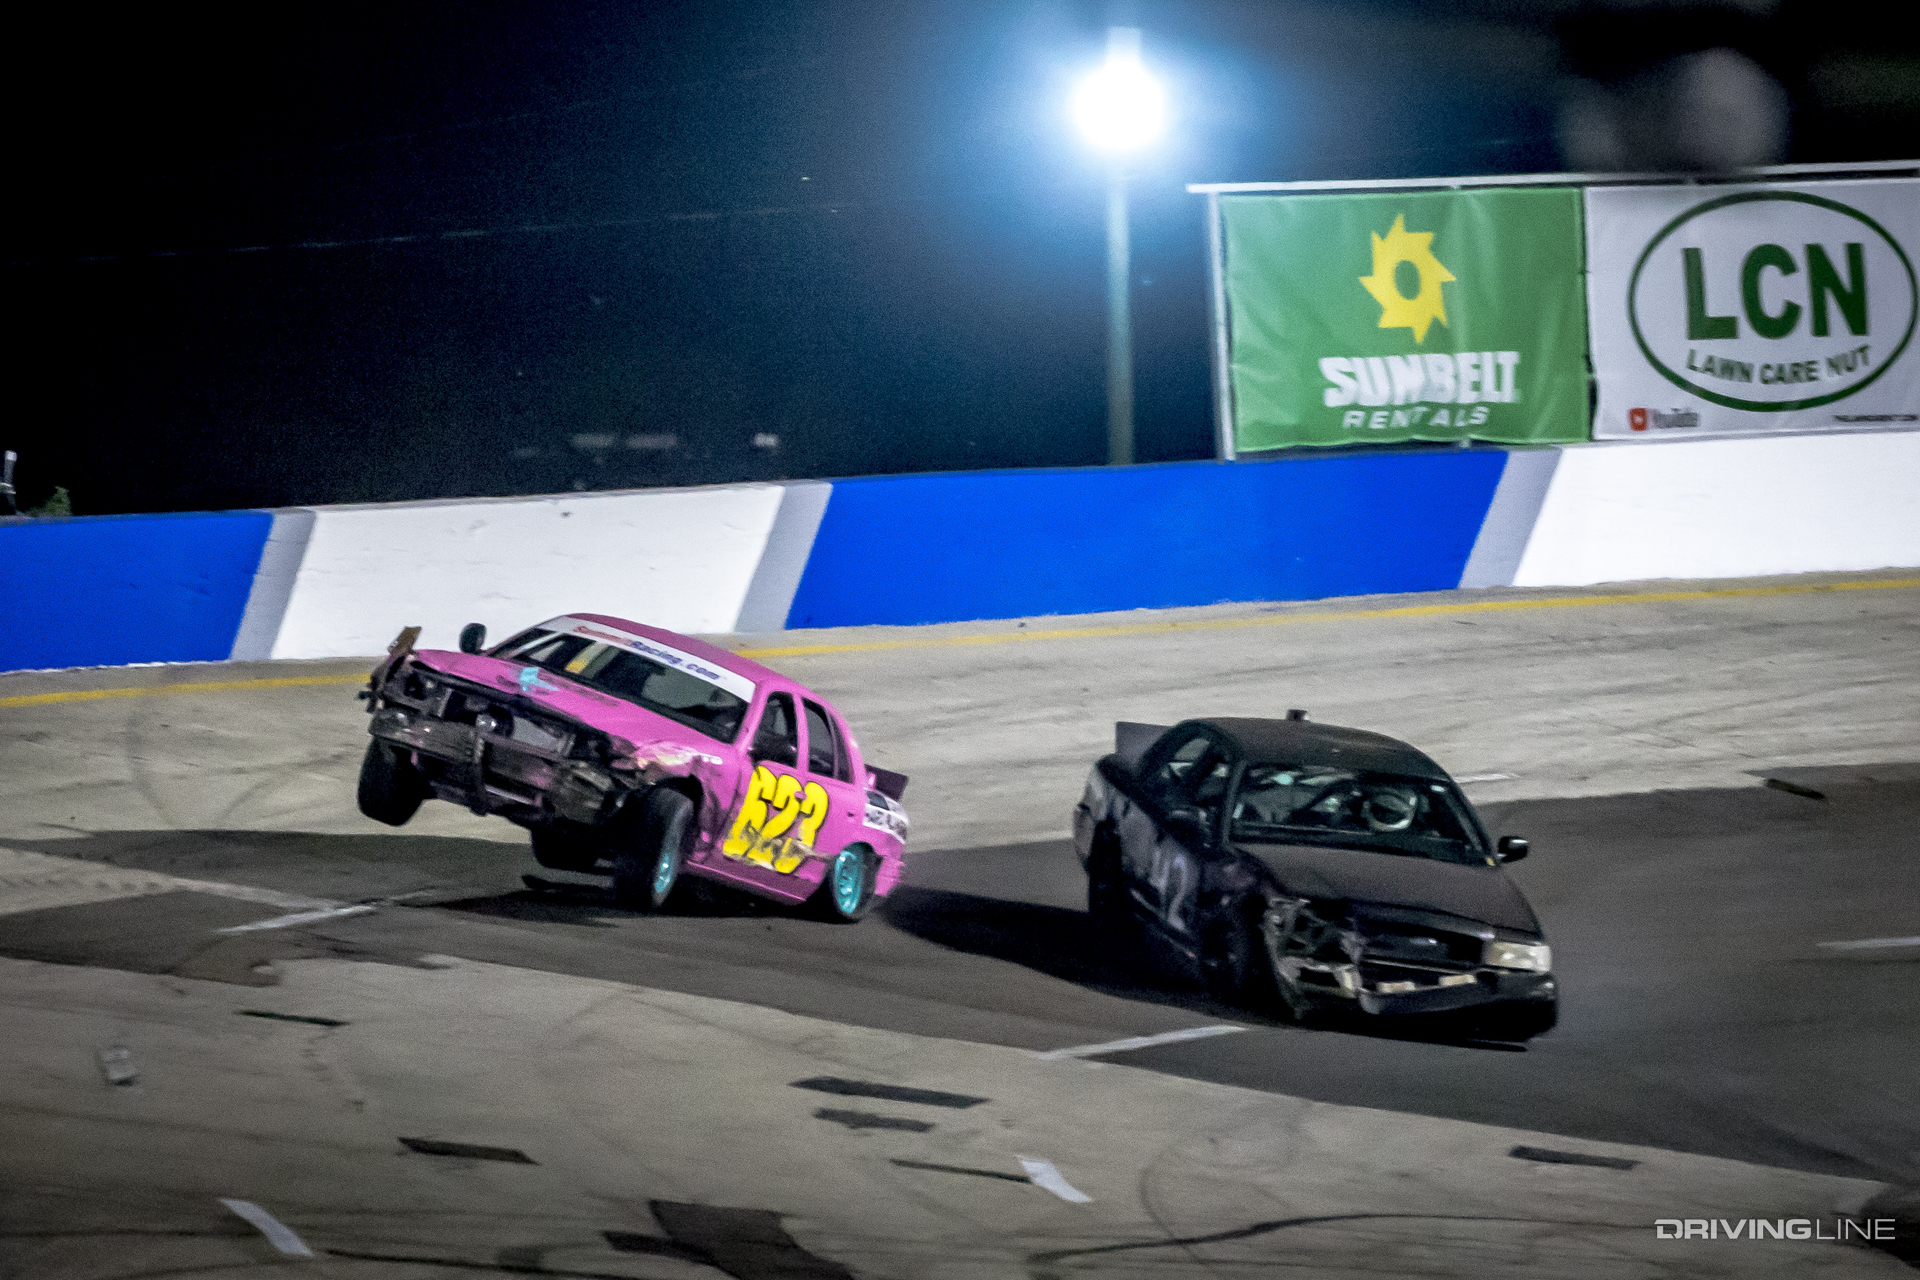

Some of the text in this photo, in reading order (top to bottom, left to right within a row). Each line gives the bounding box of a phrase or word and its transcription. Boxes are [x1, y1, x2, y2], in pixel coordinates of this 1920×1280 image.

[1682, 243, 1868, 340] LCN
[1319, 350, 1520, 408] SUNBELT
[1686, 344, 1872, 385] LAWN CARE NUT
[1343, 406, 1490, 430] RENTALS
[573, 625, 720, 680] SRacing.com
